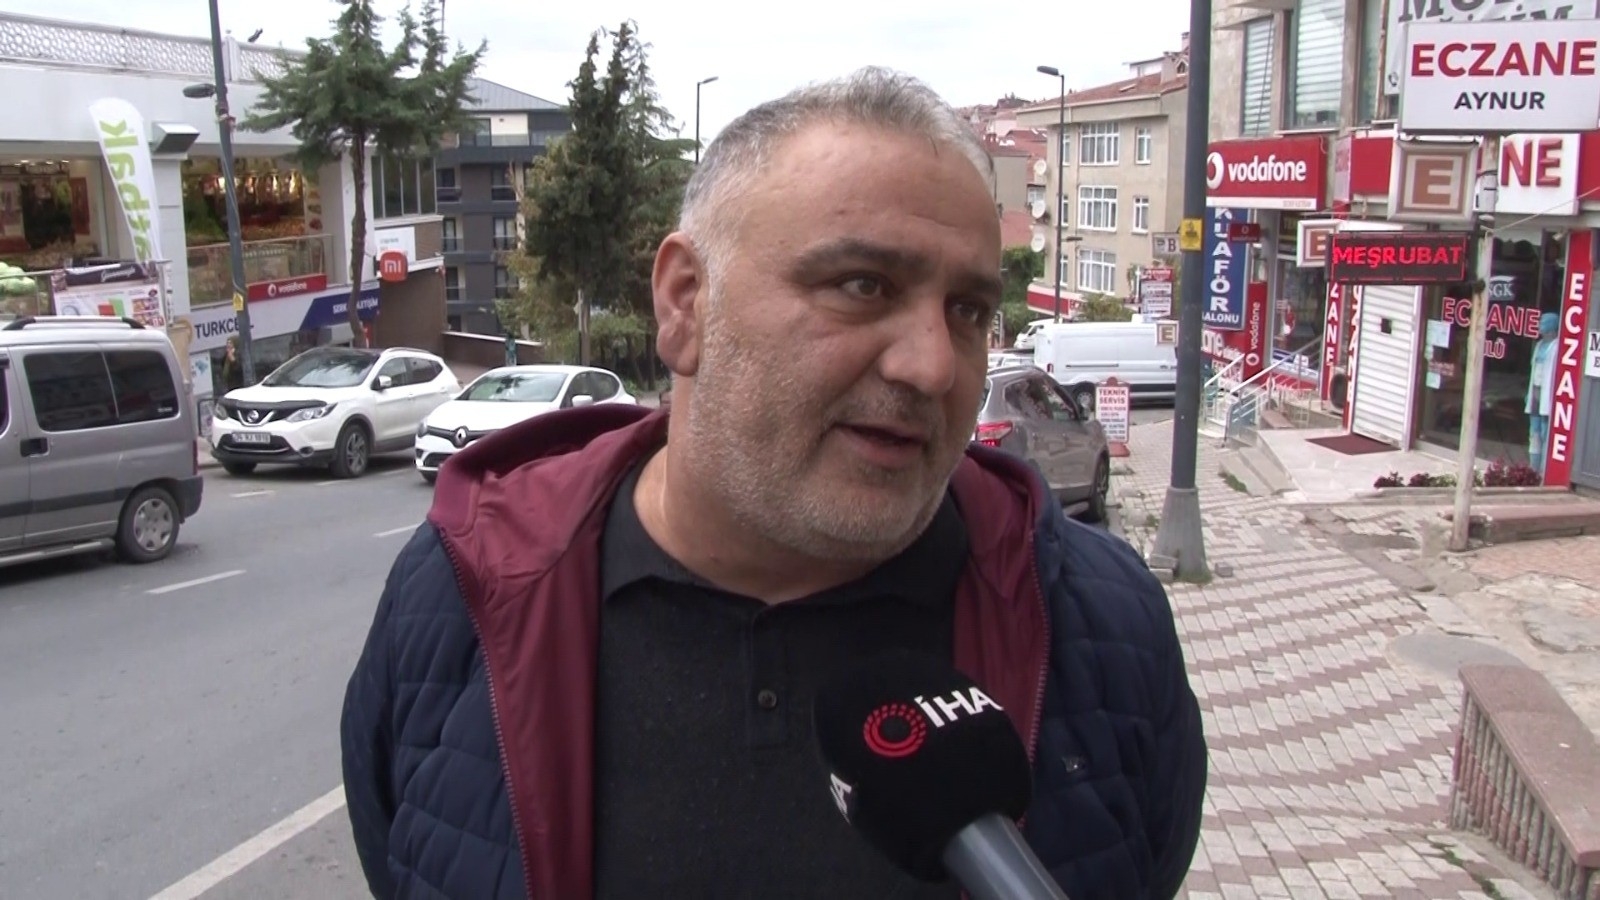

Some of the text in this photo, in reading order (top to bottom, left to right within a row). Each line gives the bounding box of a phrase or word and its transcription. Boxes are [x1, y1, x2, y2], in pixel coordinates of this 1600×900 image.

[1411, 41, 1597, 77] ECZANE
[1454, 91, 1545, 110] AYNUR
[1228, 154, 1307, 182] vodafone
[1332, 246, 1462, 268] MEŞRUBAT
[194, 317, 254, 339] TURKCE
[1441, 297, 1541, 338] ECANE
[1484, 337, 1506, 359] LÜ
[1552, 273, 1585, 461] ECZANE
[914, 686, 1004, 728] İHA
